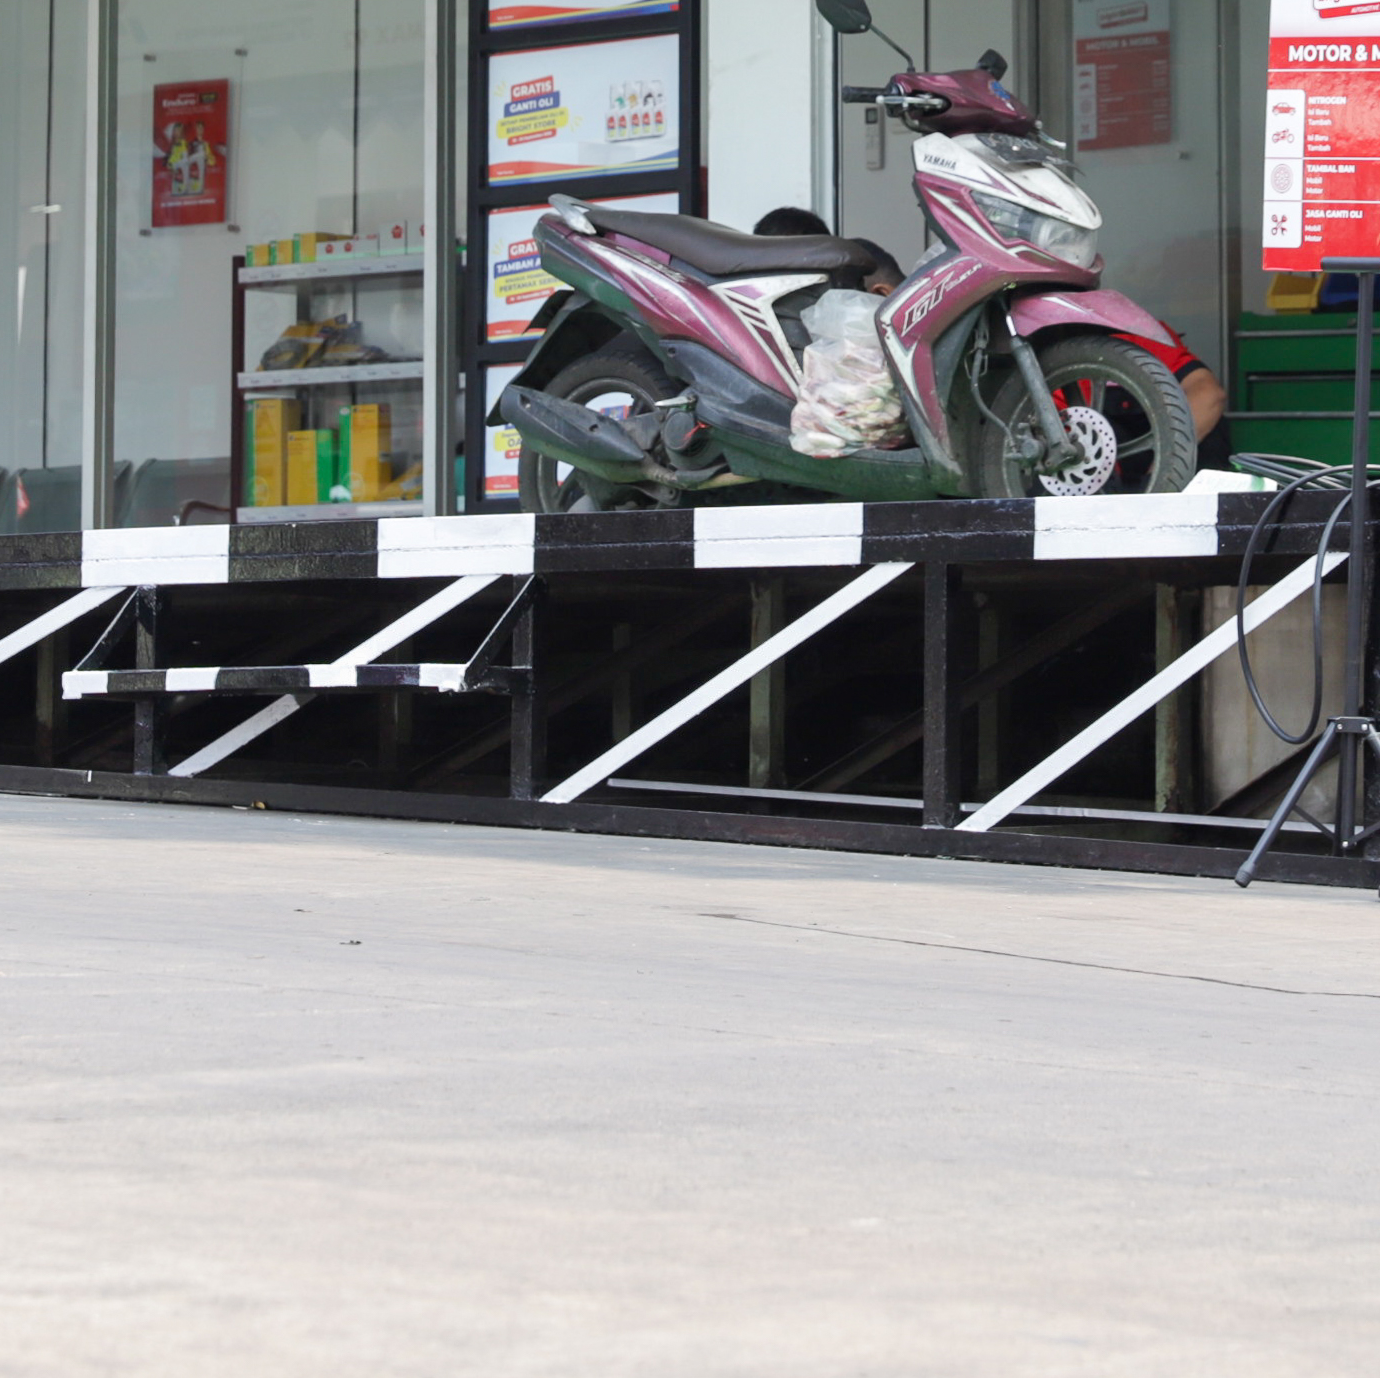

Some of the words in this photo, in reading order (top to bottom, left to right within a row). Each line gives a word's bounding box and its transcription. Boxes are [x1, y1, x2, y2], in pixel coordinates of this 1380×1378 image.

[1288, 44, 1352, 62] MOTOR
[1354, 43, 1368, 62] &
[512, 81, 553, 98] GRATIS
[509, 99, 537, 113] GANTI
[537, 96, 554, 108] OLI
[1308, 96, 1347, 105] NITROGEN
[923, 153, 957, 171] YAMAHA
[1306, 164, 1338, 173] TAMBAL
[1338, 164, 1356, 173] BAN
[1305, 210, 1325, 219] JASA
[1325, 210, 1349, 219] GANTI
[1349, 210, 1363, 220] OLI
